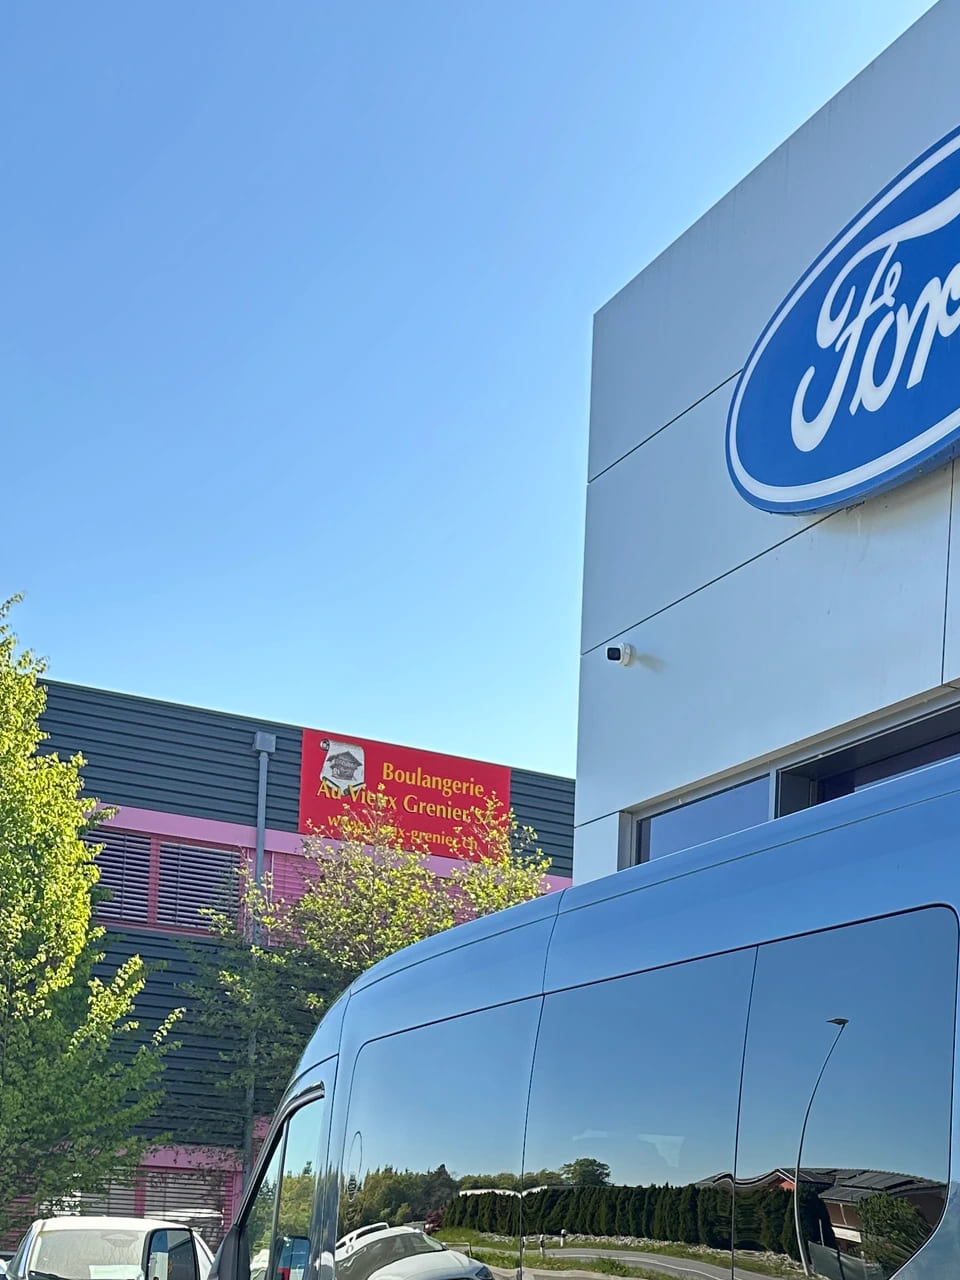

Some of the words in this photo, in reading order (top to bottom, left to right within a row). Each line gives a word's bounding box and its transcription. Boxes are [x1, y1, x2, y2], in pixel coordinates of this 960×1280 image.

[382, 761, 484, 797] Boulangerie
[316, 780, 342, 800] Au
[403, 794, 471, 822] Grenier
